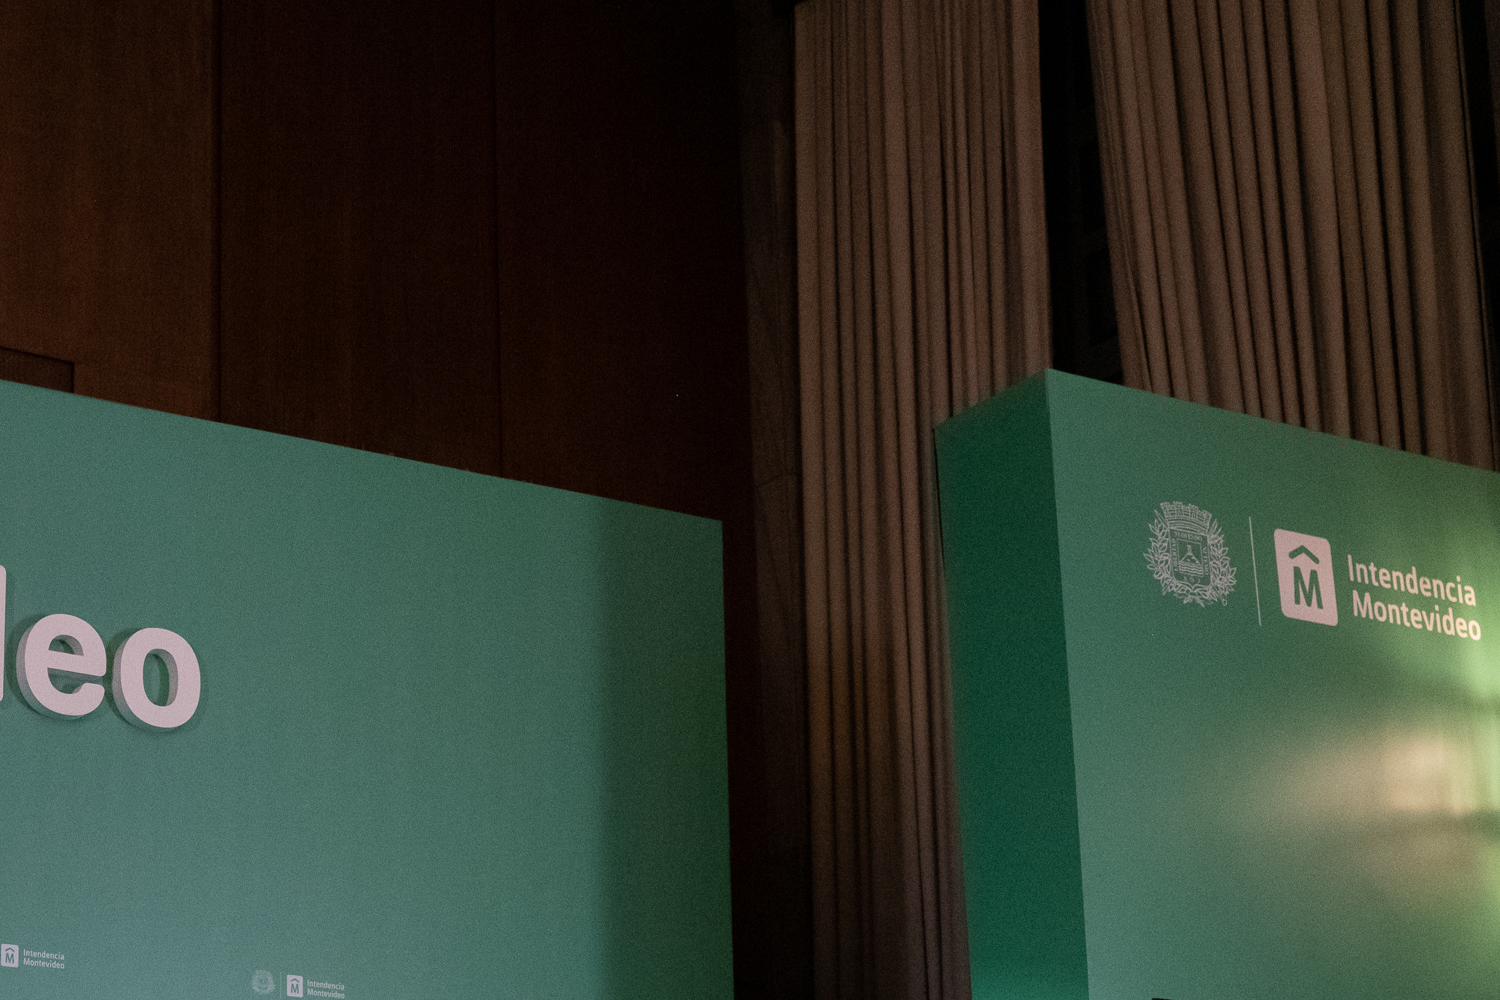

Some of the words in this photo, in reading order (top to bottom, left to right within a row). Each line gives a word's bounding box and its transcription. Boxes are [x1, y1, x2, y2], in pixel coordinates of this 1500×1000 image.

[1348, 554, 1476, 606] Intendencia
[1352, 590, 1481, 641] Montevideo
[23, 949, 65, 960] Intendencia
[23, 958, 65, 969] Montevideo
[307, 980, 345, 991] Intendencia
[307, 988, 345, 999] Montevideo
